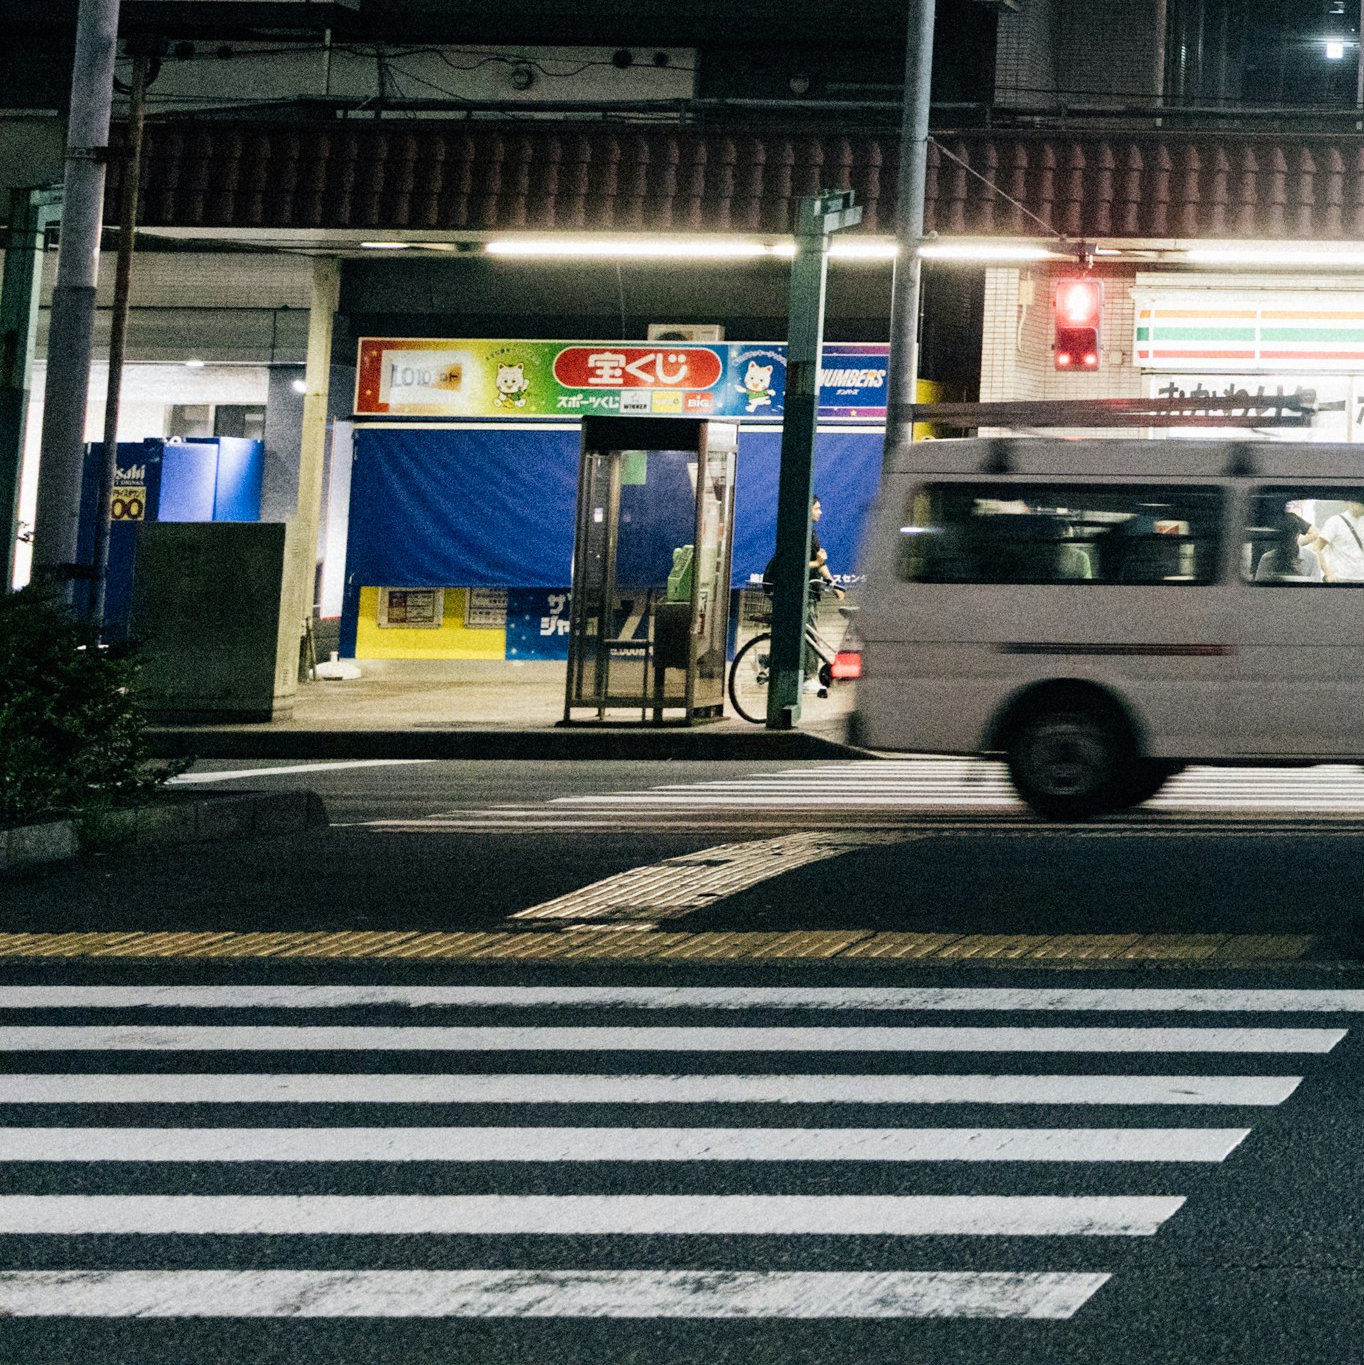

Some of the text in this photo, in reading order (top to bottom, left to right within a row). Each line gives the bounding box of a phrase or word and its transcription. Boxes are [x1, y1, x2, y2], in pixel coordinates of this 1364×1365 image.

[587, 352, 688, 384] 宝くじ
[556, 394, 620, 409] スポーツくじ
[114, 464, 146, 480] sahi
